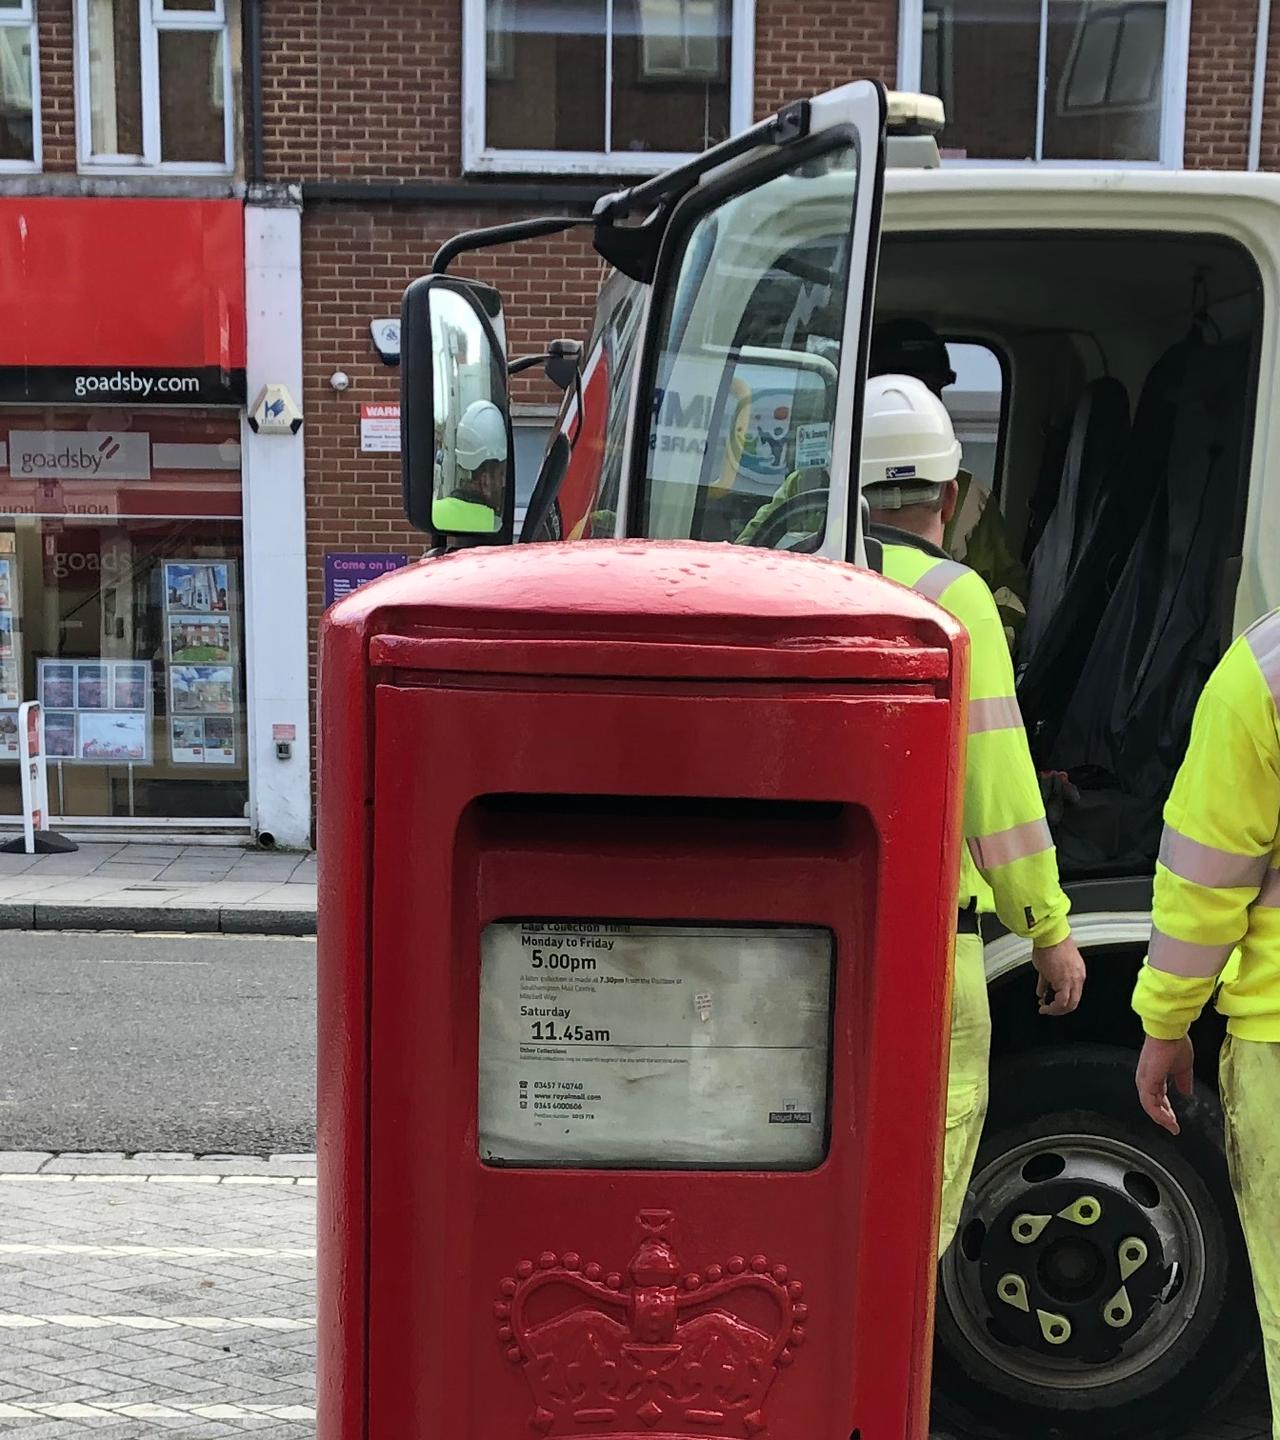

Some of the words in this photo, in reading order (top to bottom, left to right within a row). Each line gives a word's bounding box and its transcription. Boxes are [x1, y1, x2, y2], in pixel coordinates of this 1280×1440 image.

[75, 371, 200, 396] goadsby.com
[21, 448, 103, 474] goadsby
[53, 545, 133, 578] goads
[333, 560, 366, 569] Come
[368, 561, 383, 569] on
[521, 936, 564, 949] Monday
[566, 937, 578, 947] to
[580, 937, 615, 950] Friday
[531, 949, 597, 972] 5.00pm
[599, 977, 625, 985] 7.30pm
[520, 1005, 571, 1019] Saturday
[531, 1021, 610, 1042] 11.45am
[534, 1081, 556, 1089] 03457
[557, 1082, 584, 1090] 740740
